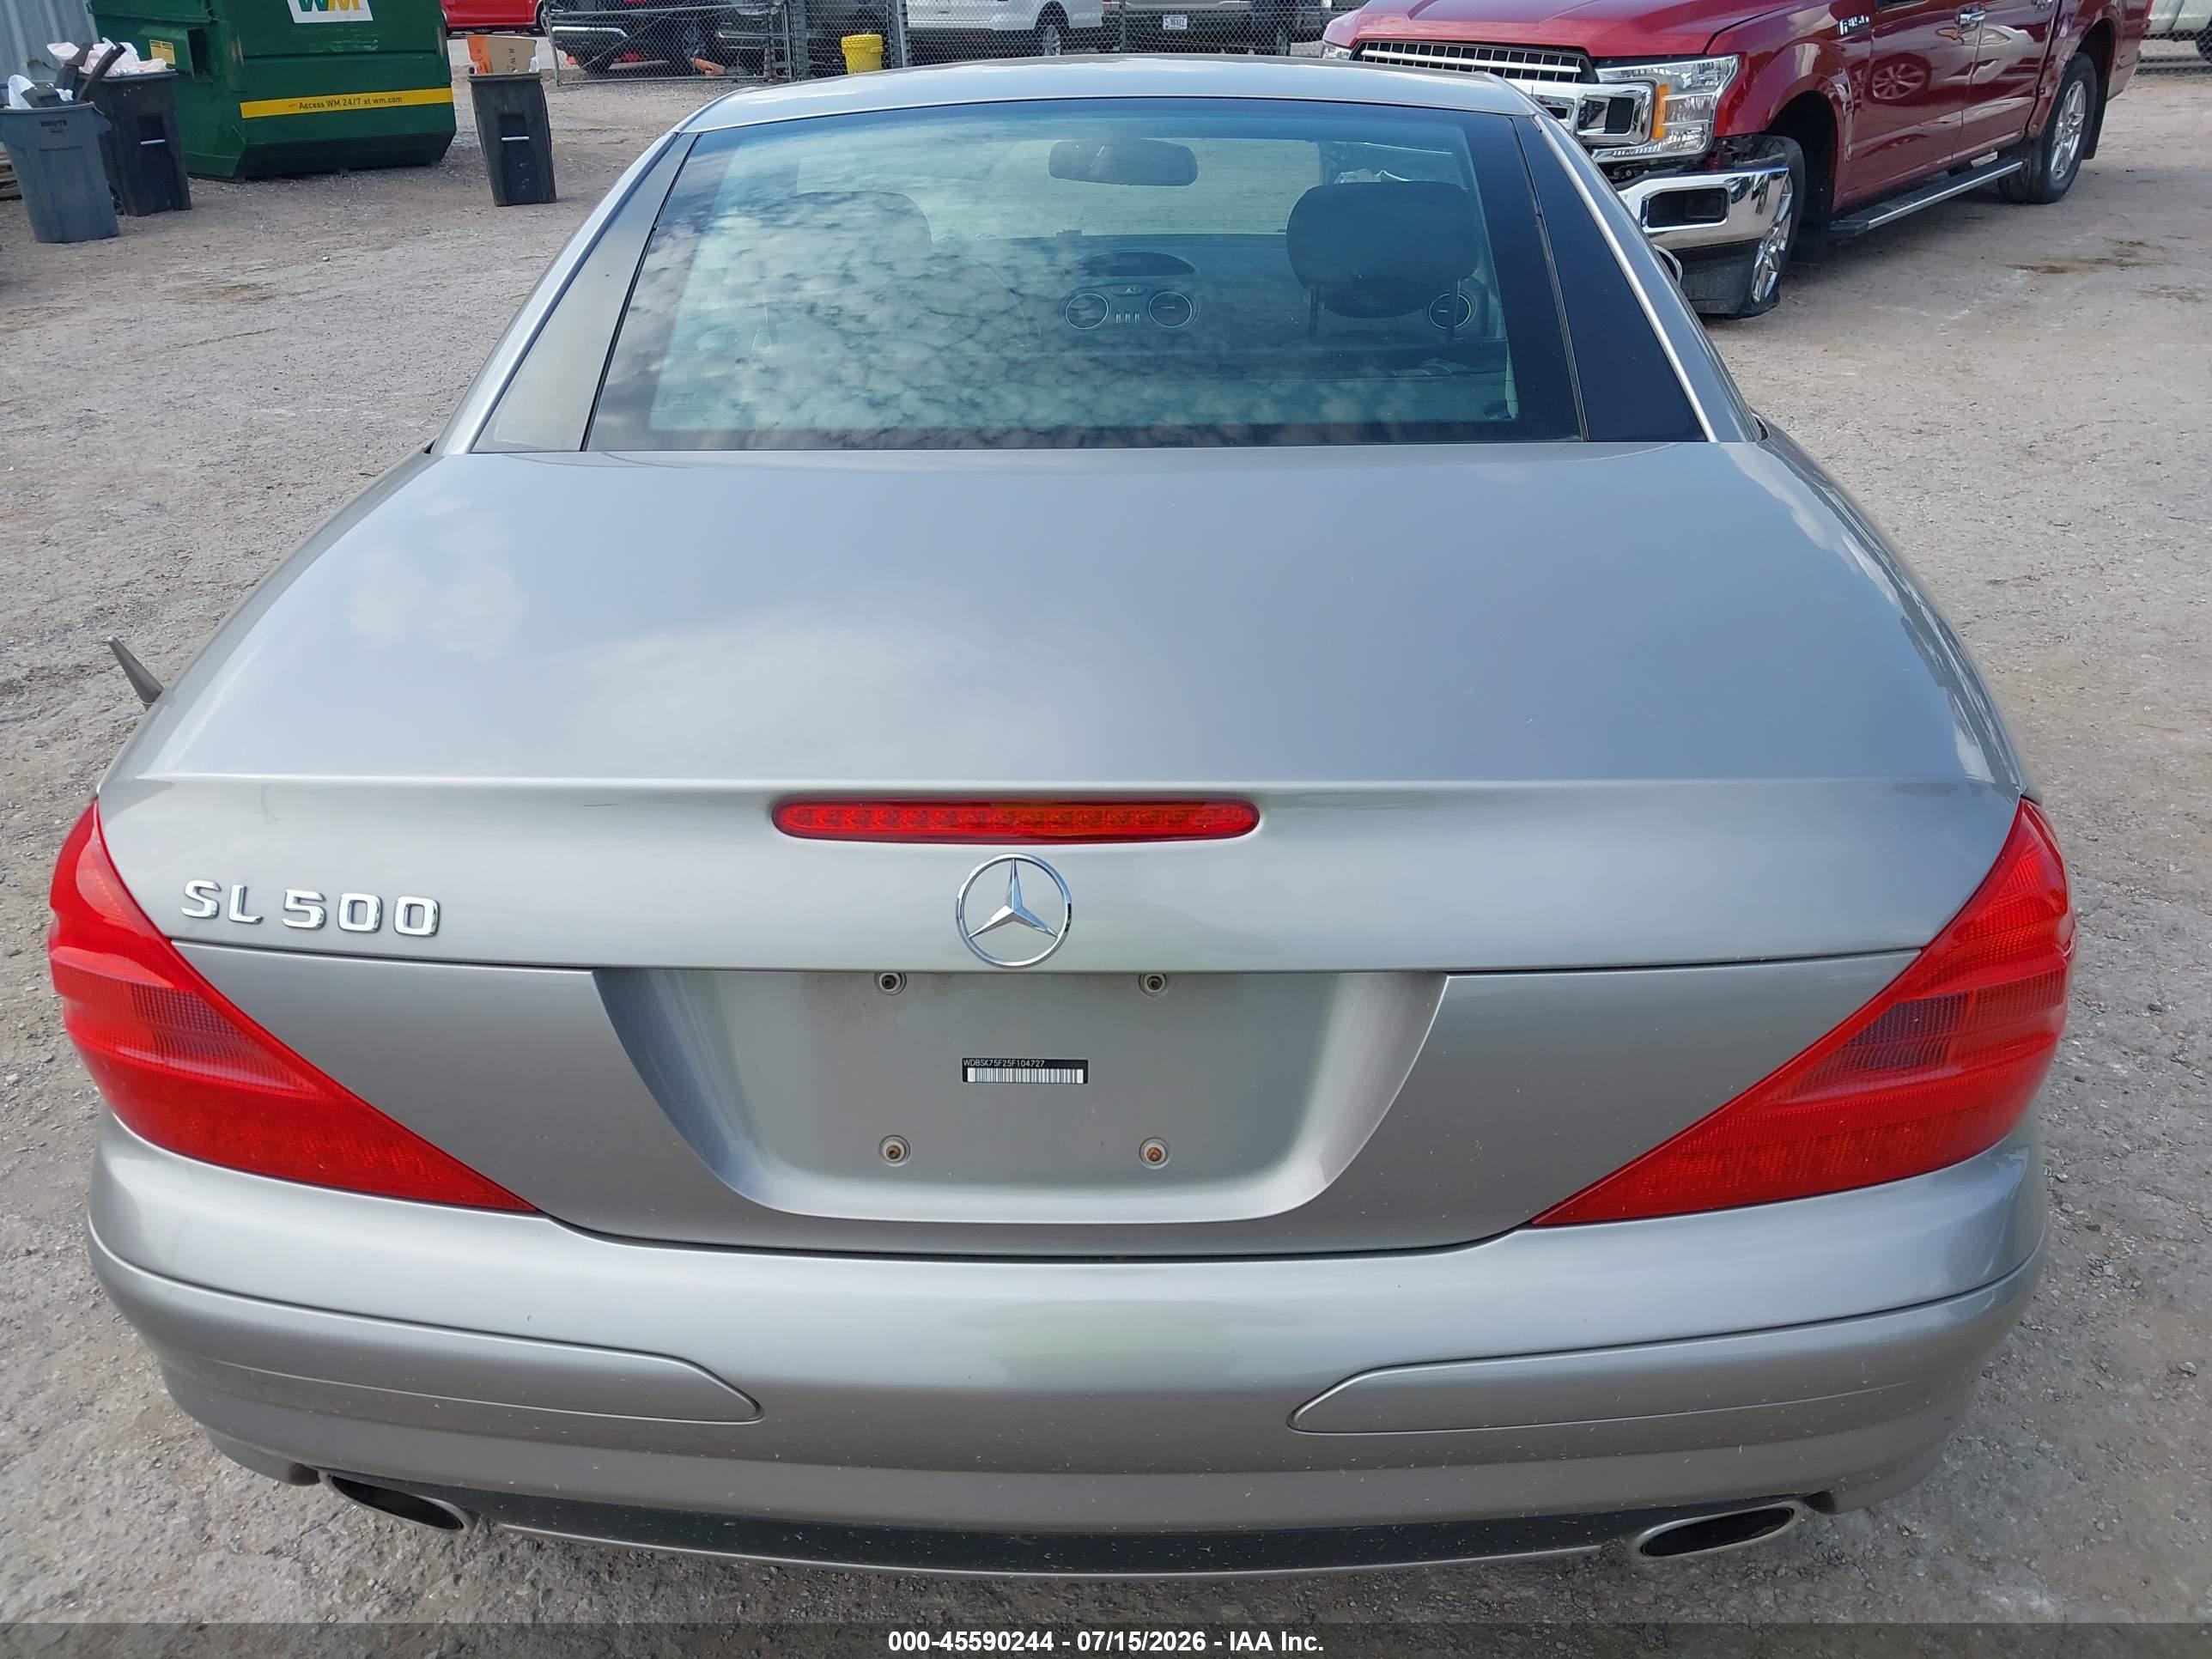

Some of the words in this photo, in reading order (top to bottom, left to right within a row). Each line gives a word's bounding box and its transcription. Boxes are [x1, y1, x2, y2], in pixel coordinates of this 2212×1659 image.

[299, 101, 325, 110] Access
[325, 99, 341, 108] WM
[343, 97, 362, 106] 24/7
[180, 878, 264, 925] SL
[282, 889, 441, 937] 500
[963, 1059, 1045, 1067] WDBSK75F25F104727
